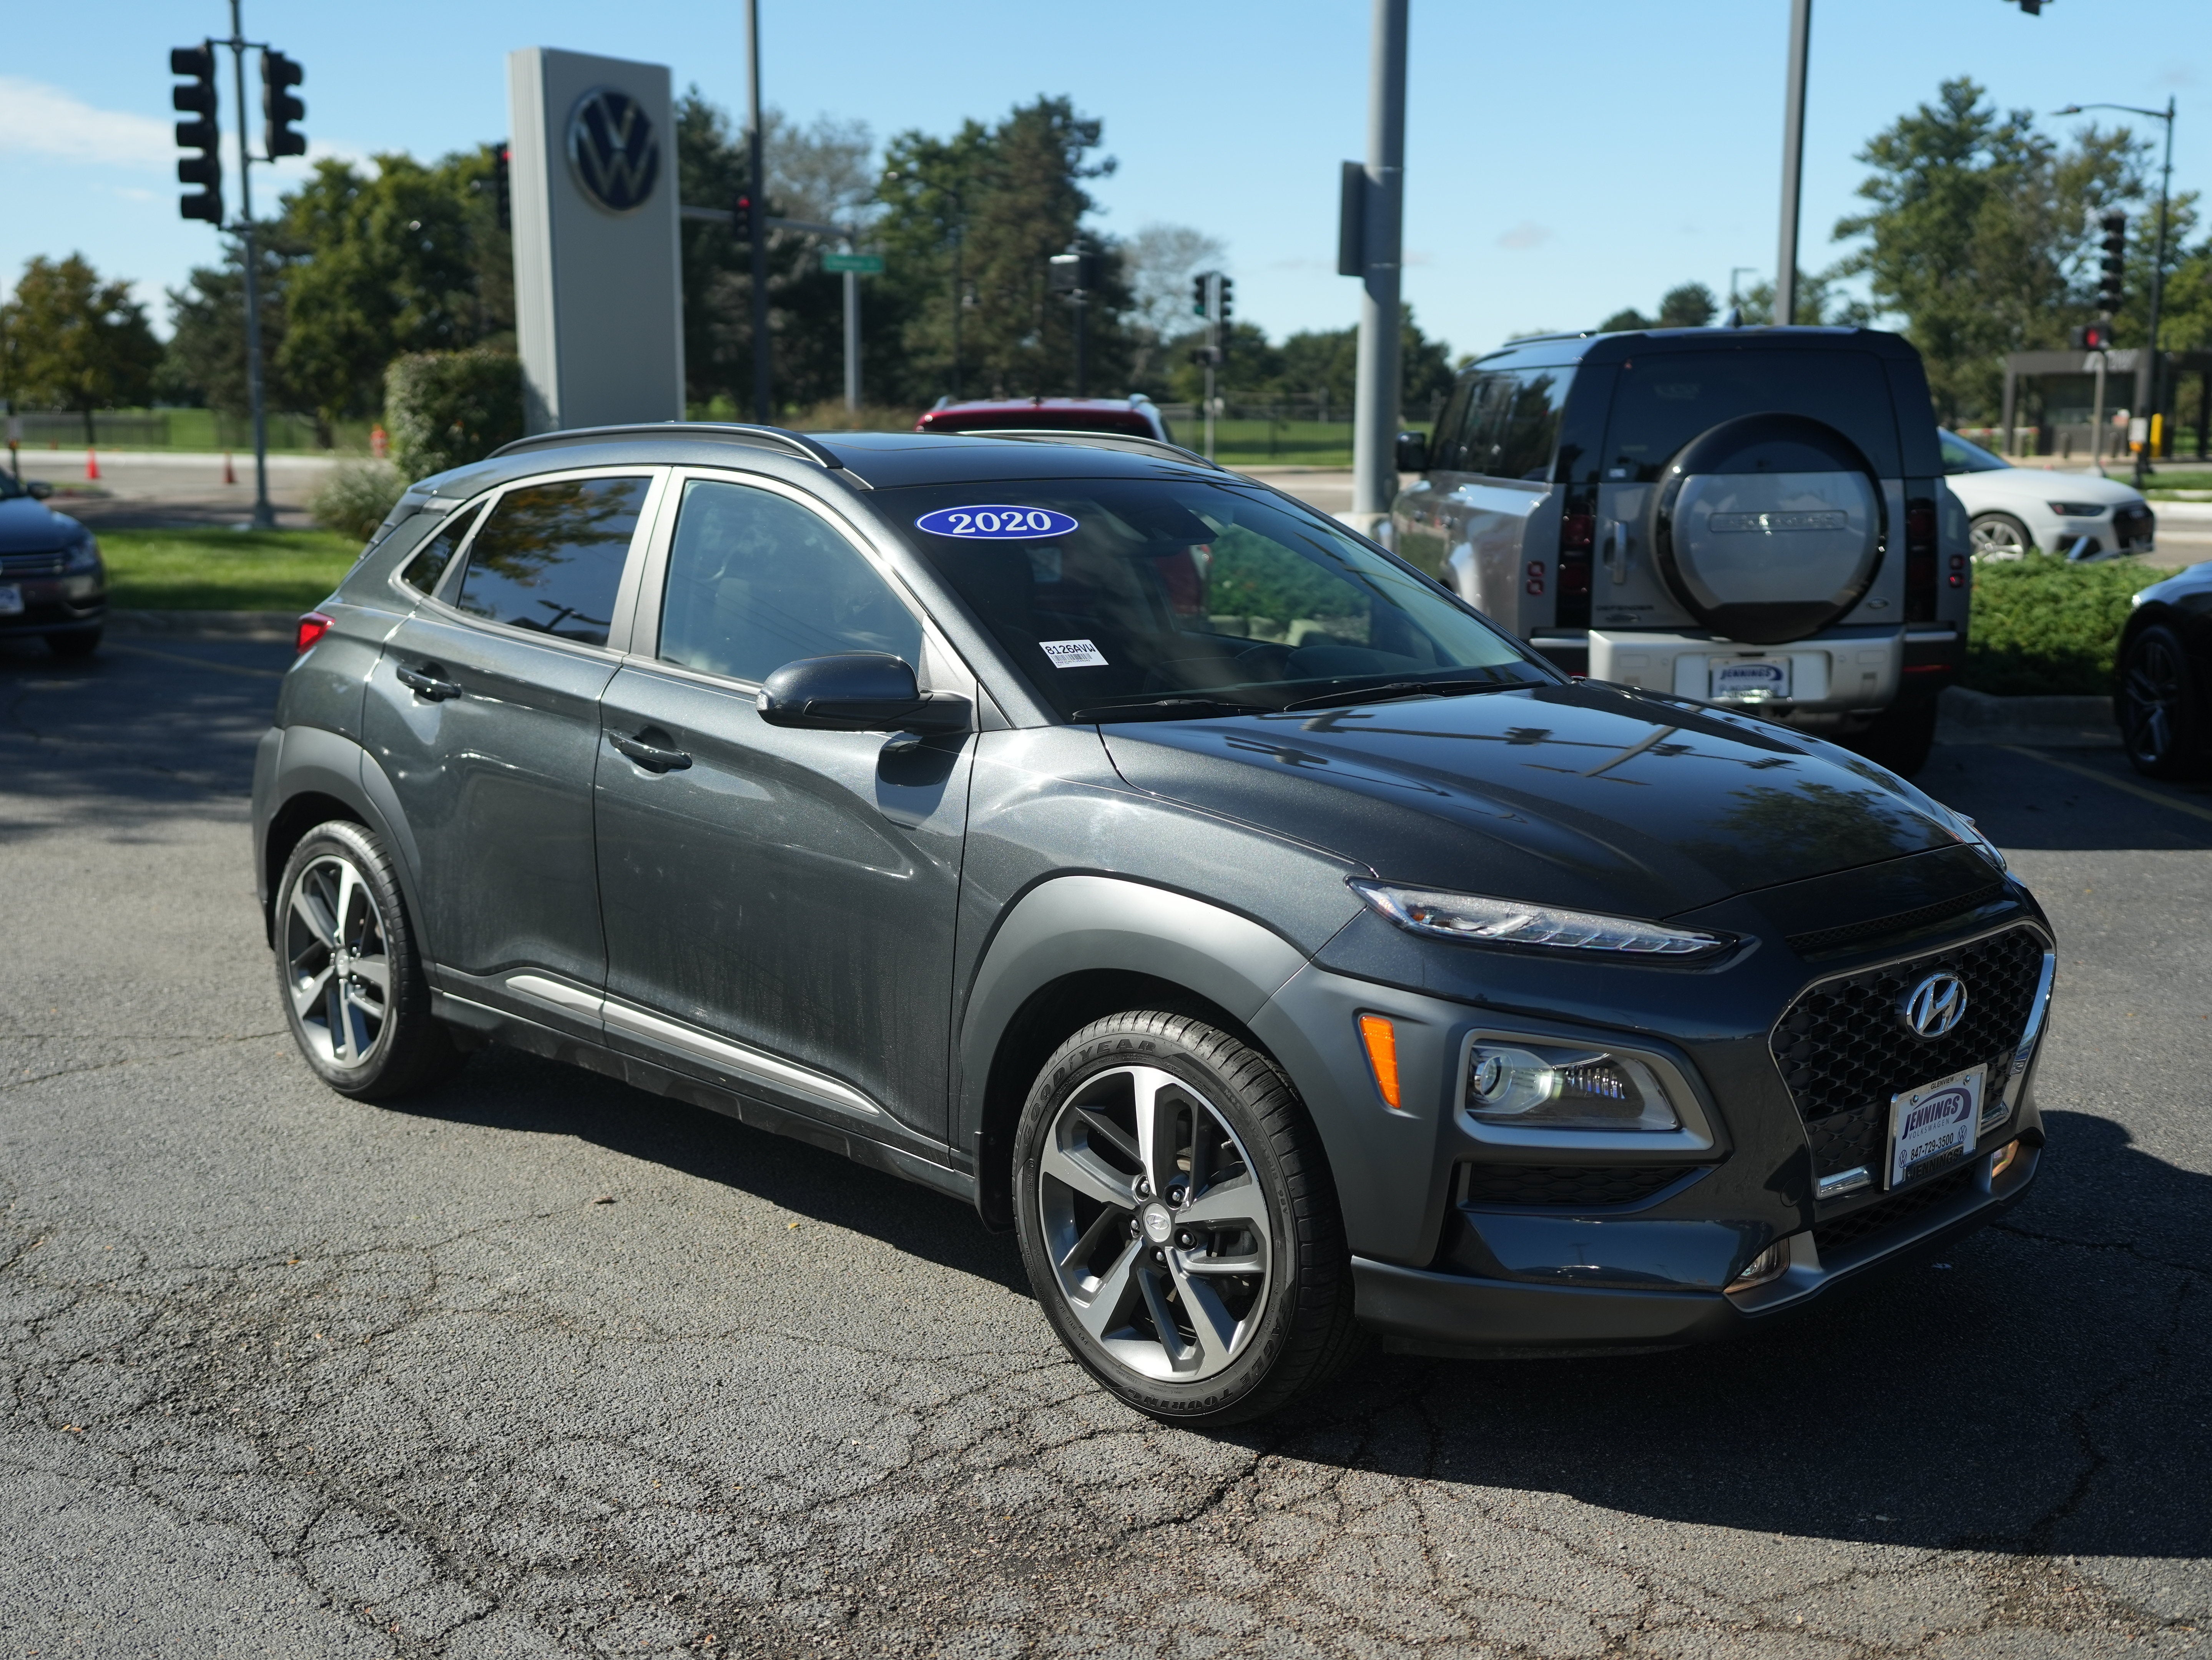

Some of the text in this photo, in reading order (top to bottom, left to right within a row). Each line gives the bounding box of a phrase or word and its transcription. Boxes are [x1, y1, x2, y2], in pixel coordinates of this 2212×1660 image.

[948, 511, 1052, 533] 2020
[1045, 644, 1096, 654] 8126AVW
[1931, 1076, 1954, 1089] GLENVIEW
[1902, 1095, 1960, 1140] JENNINGS
[1909, 1118, 1949, 1140] VOLKSWAGEN
[1911, 1132, 1953, 1160] 847-729-3500
[1910, 1148, 1960, 1180] JENNINGS
[1127, 1388, 1233, 1410] TOURING
